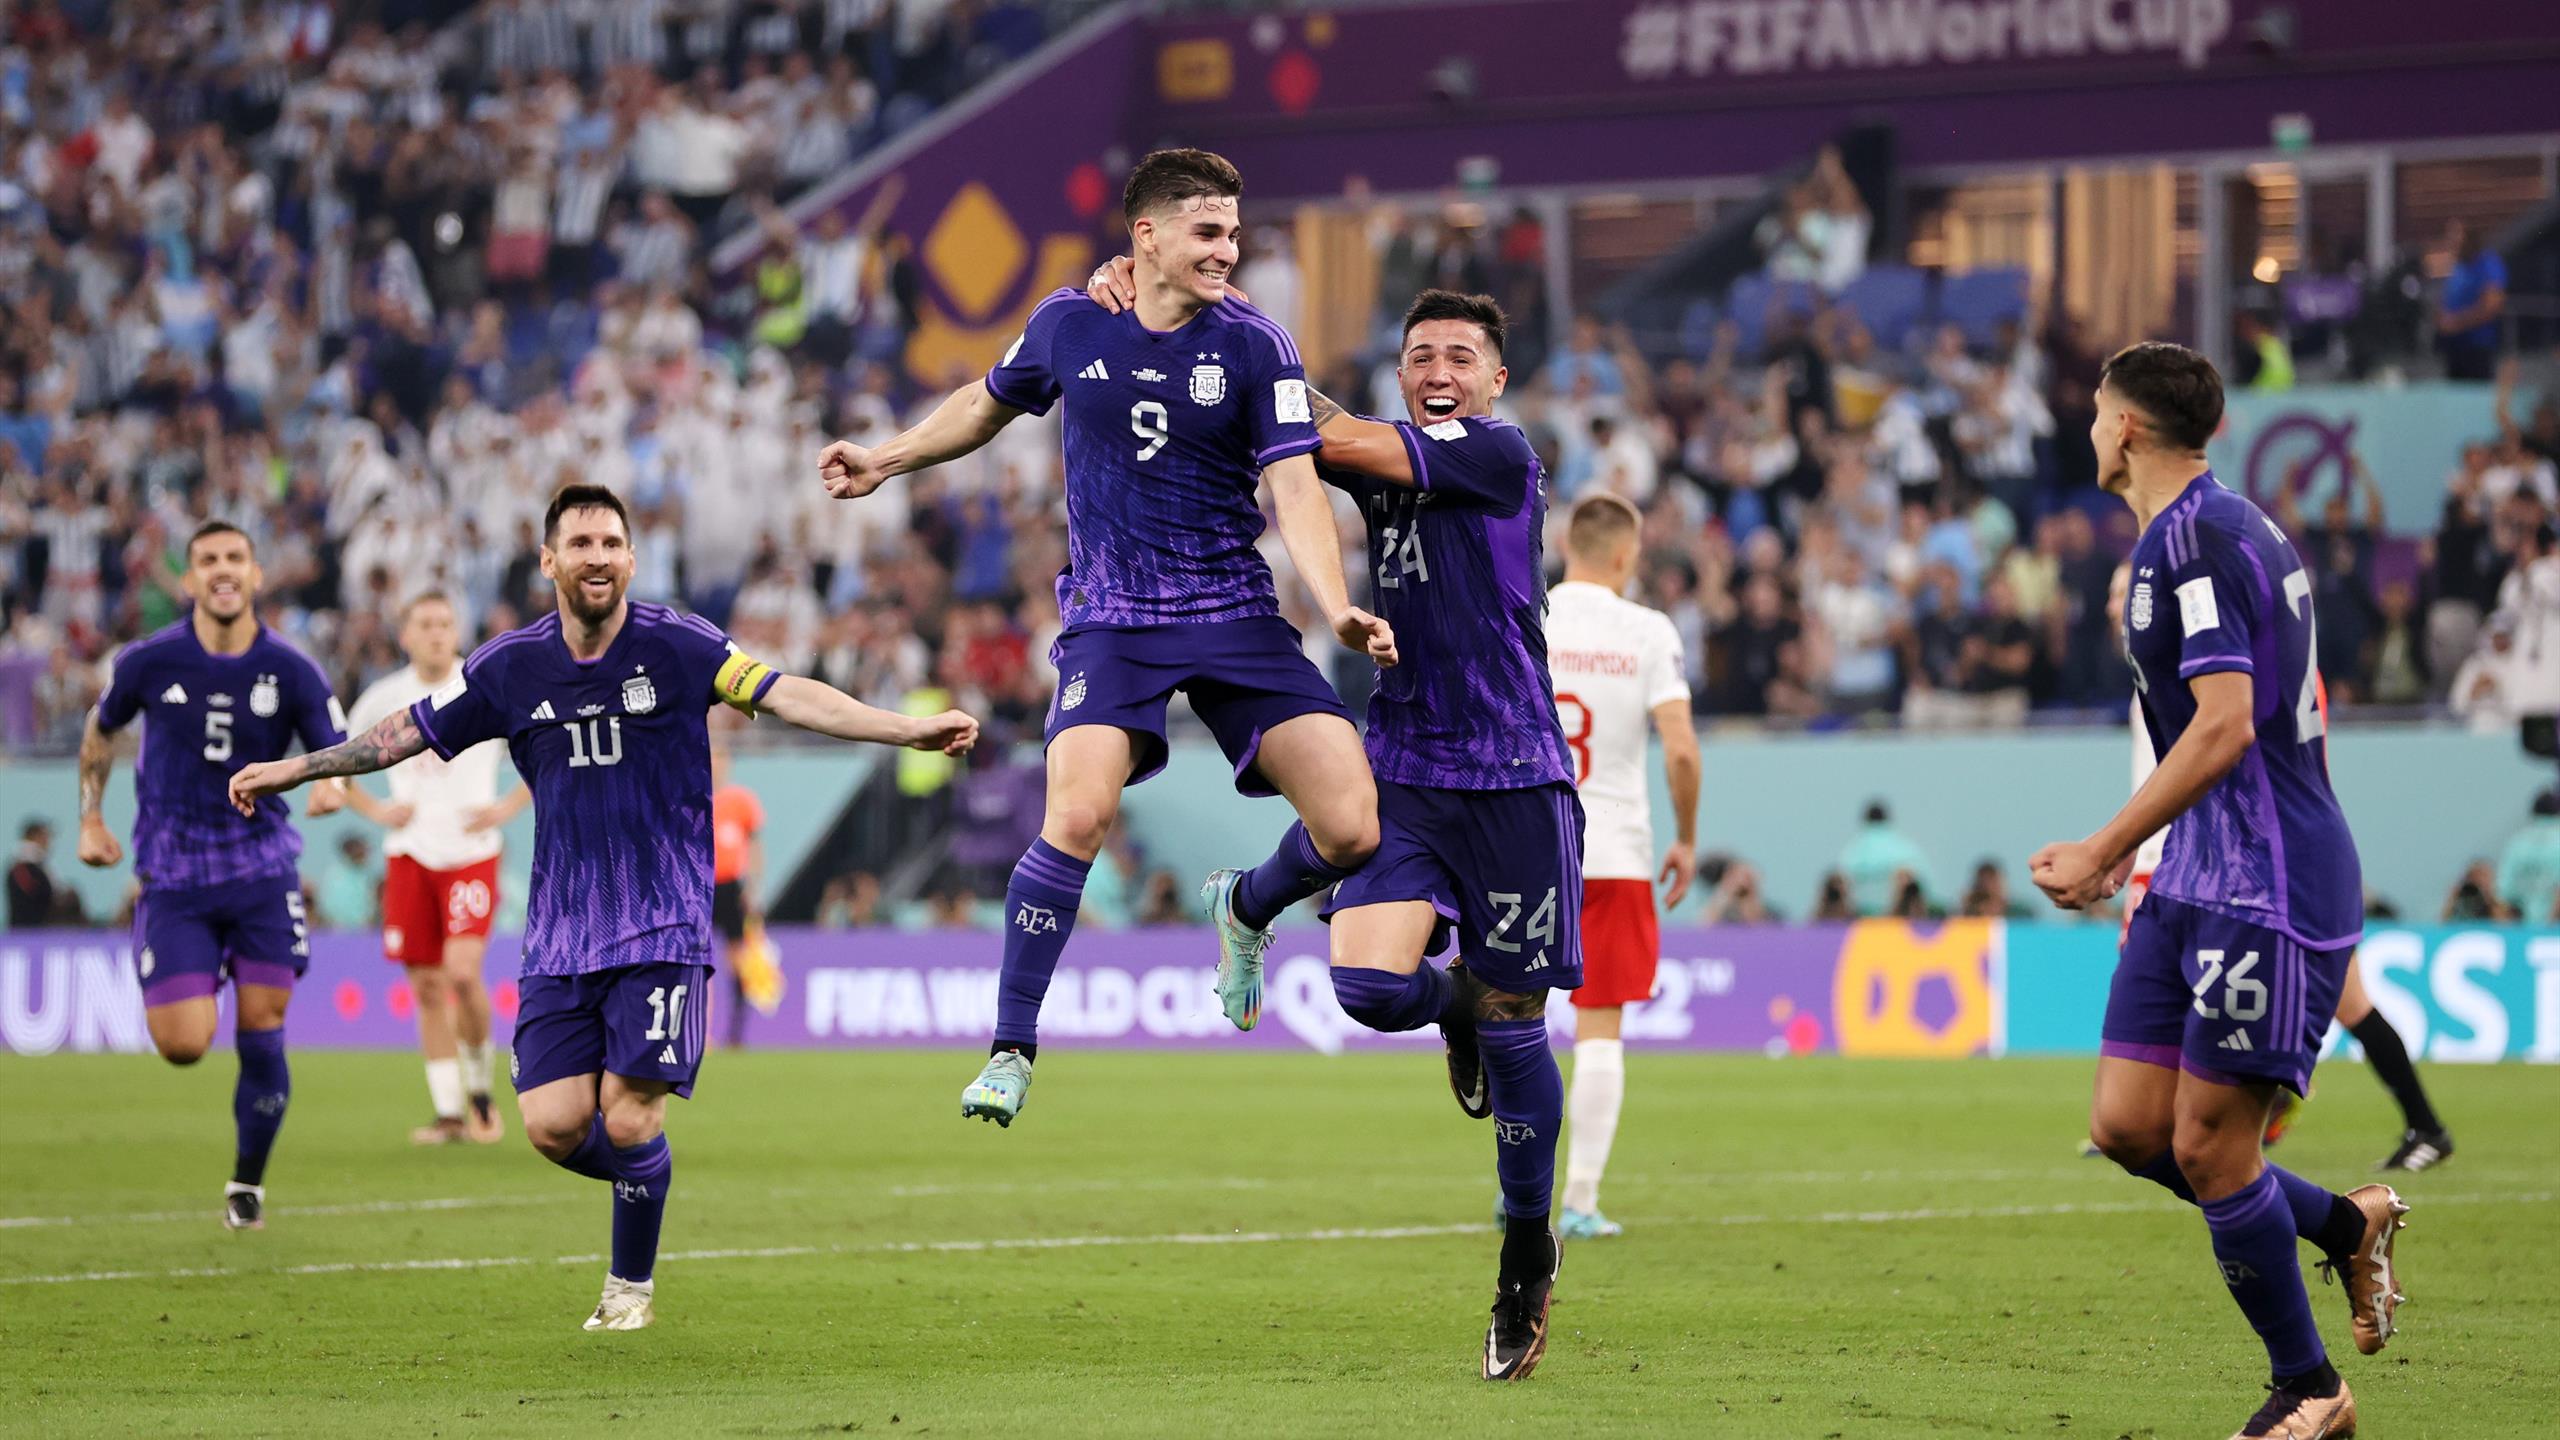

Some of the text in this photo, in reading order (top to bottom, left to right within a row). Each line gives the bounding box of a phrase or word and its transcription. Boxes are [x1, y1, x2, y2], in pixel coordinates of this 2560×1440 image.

[1620, 0, 2231, 77] #FIFAWorldCup
[1131, 401, 1168, 461] 9
[1377, 519, 1430, 589] 24
[203, 711, 235, 772] 5
[562, 716, 623, 767] 10
[448, 879, 491, 920] 20
[1015, 901, 1058, 935] AFA
[1486, 887, 1556, 953] 24
[1, 945, 160, 1057] UN
[645, 985, 688, 1041] 10
[805, 966, 932, 1037] FIFA
[2193, 949, 2268, 1022] 26
